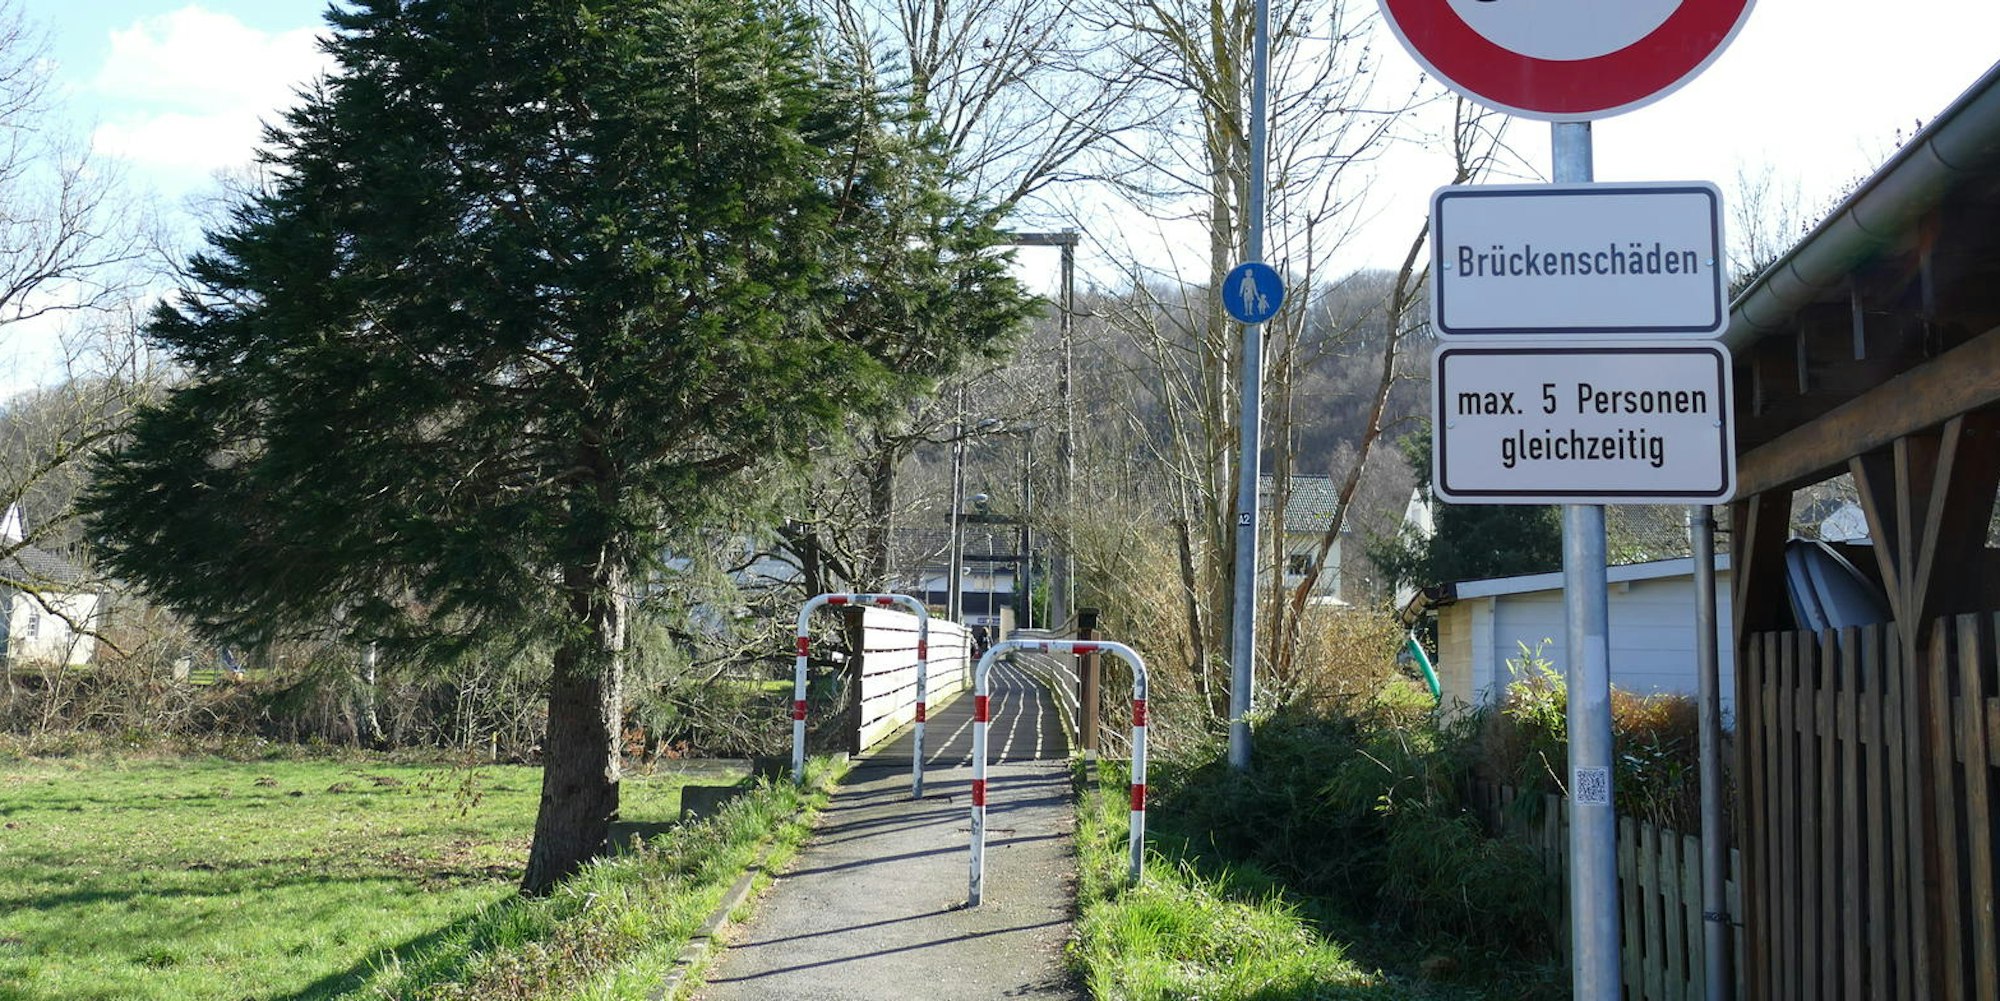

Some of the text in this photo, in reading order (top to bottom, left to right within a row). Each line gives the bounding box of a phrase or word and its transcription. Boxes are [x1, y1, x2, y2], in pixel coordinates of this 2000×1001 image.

[1458, 242, 1698, 277] Brückenschäden
[1458, 382, 1707, 415] max. 5 Personen
[1502, 428, 1664, 469] gleichzeitig
